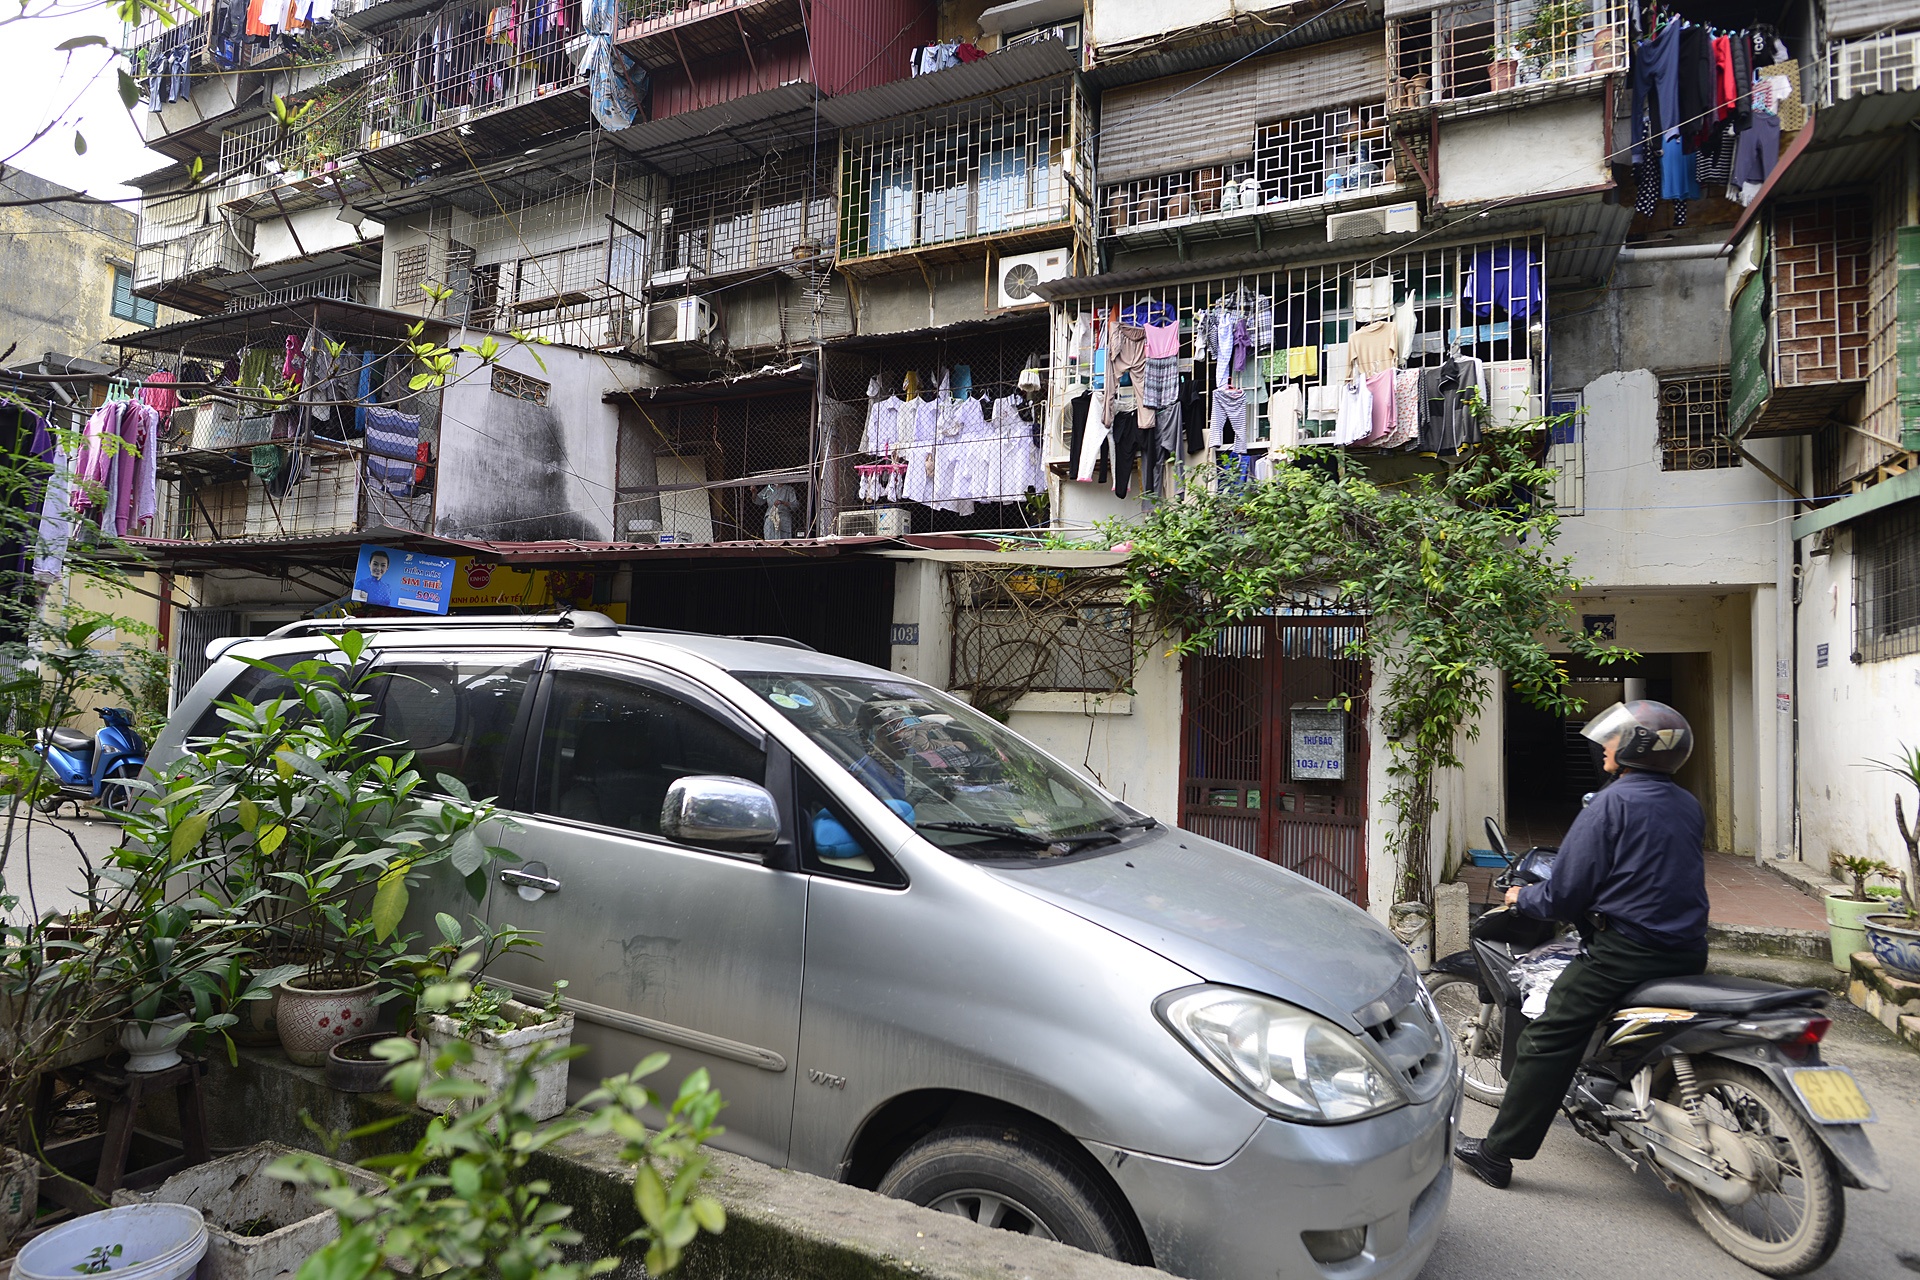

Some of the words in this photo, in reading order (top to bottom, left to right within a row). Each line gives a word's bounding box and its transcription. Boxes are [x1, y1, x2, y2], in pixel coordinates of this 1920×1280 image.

[401, 576, 421, 587] SIM
[416, 589, 441, 603] 50%
[480, 594, 489, 603] LÀ
[1327, 760, 1339, 769] E9
